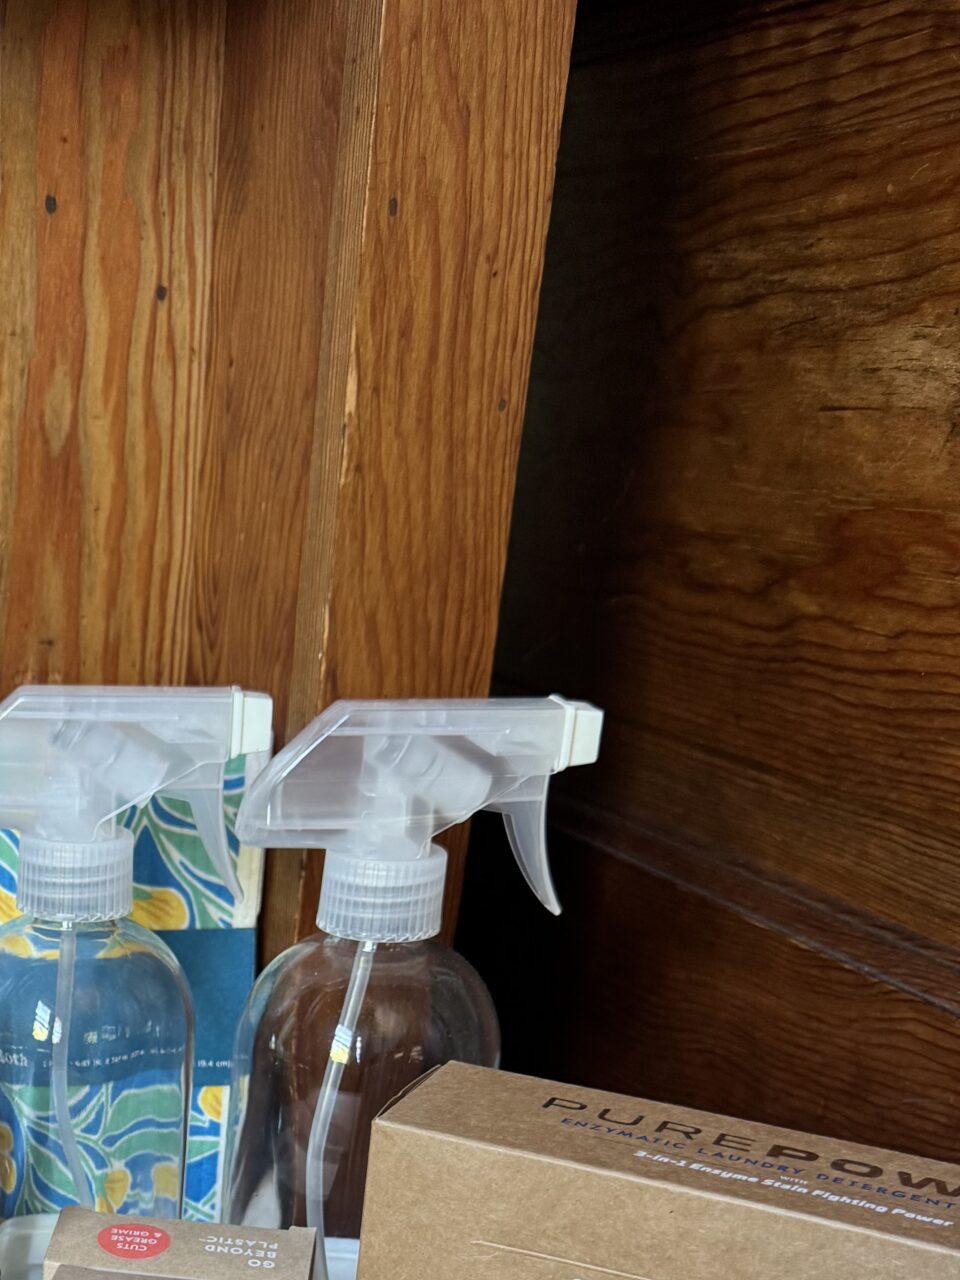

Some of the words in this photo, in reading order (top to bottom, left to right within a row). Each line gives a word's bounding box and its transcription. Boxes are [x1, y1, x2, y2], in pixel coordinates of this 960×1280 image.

[542, 1096, 960, 1198] PUREPOW
[560, 1117, 687, 1150] ENZYMATIC
[697, 1147, 806, 1175] LAUNDRY
[816, 1172, 957, 1210] DETERGENT
[688, 1158, 759, 1183] Enzyme
[760, 1178, 809, 1195] Stain
[811, 1188, 889, 1214] Fighting
[891, 1207, 955, 1228] Power
[111, 1228, 150, 1237] GRIME
[111, 1234, 158, 1245] GREASE
[116, 1242, 148, 1252] CUTS
[204, 1244, 277, 1259] BEYOND
[247, 1258, 276, 1269] GO
